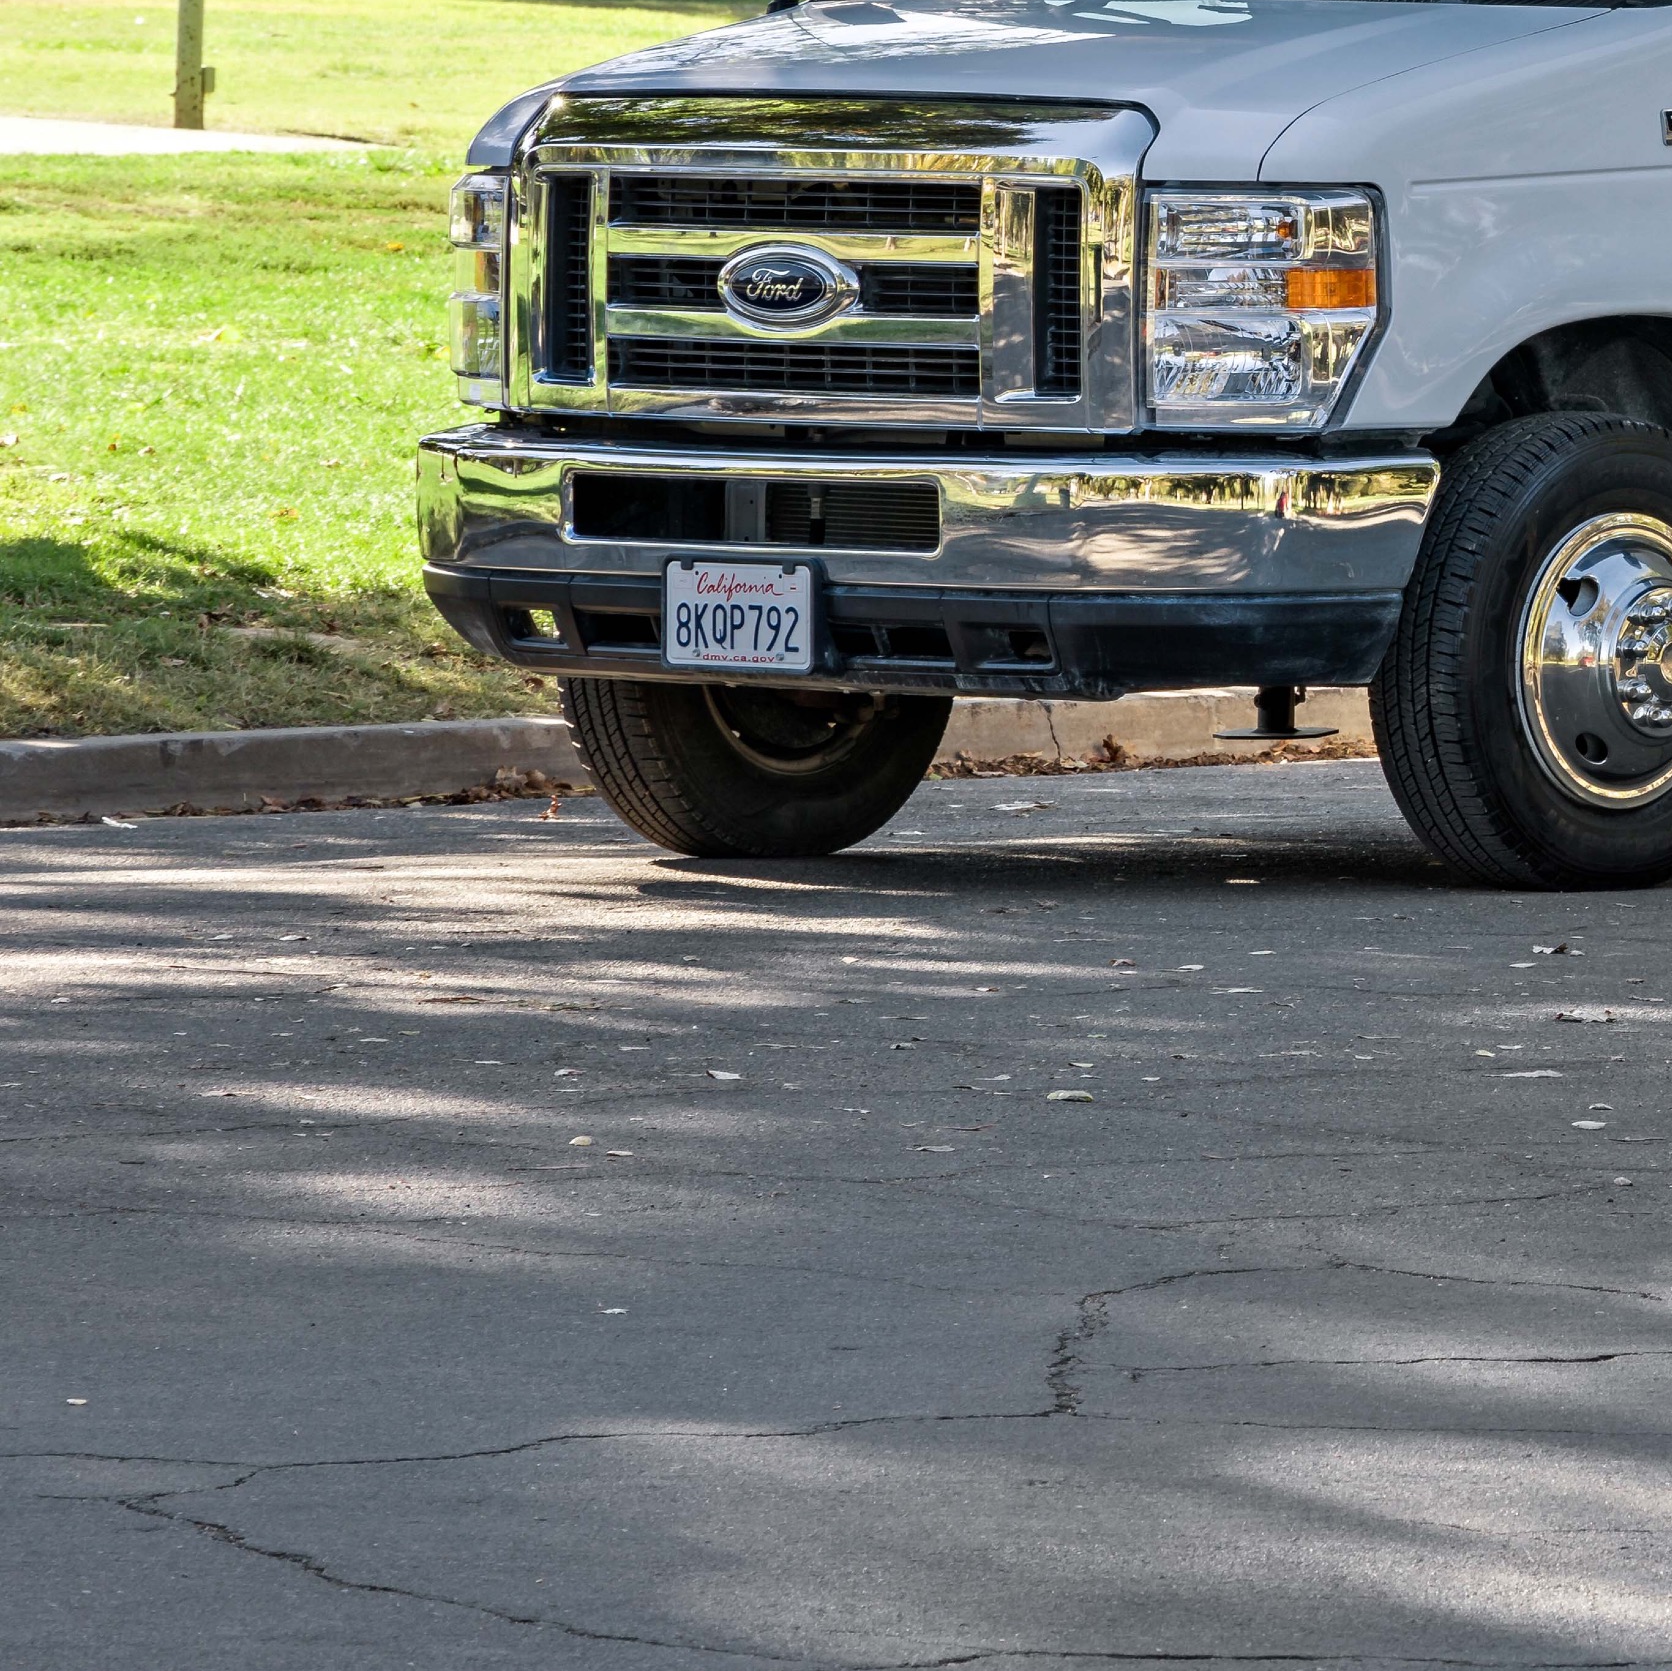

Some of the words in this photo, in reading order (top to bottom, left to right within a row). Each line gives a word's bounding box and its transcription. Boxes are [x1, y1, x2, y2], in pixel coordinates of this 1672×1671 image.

[746, 268, 804, 301] Ford
[696, 571, 784, 602] California
[676, 602, 800, 653] 8KQP792
[702, 652, 775, 663] dmv.ca.gov
